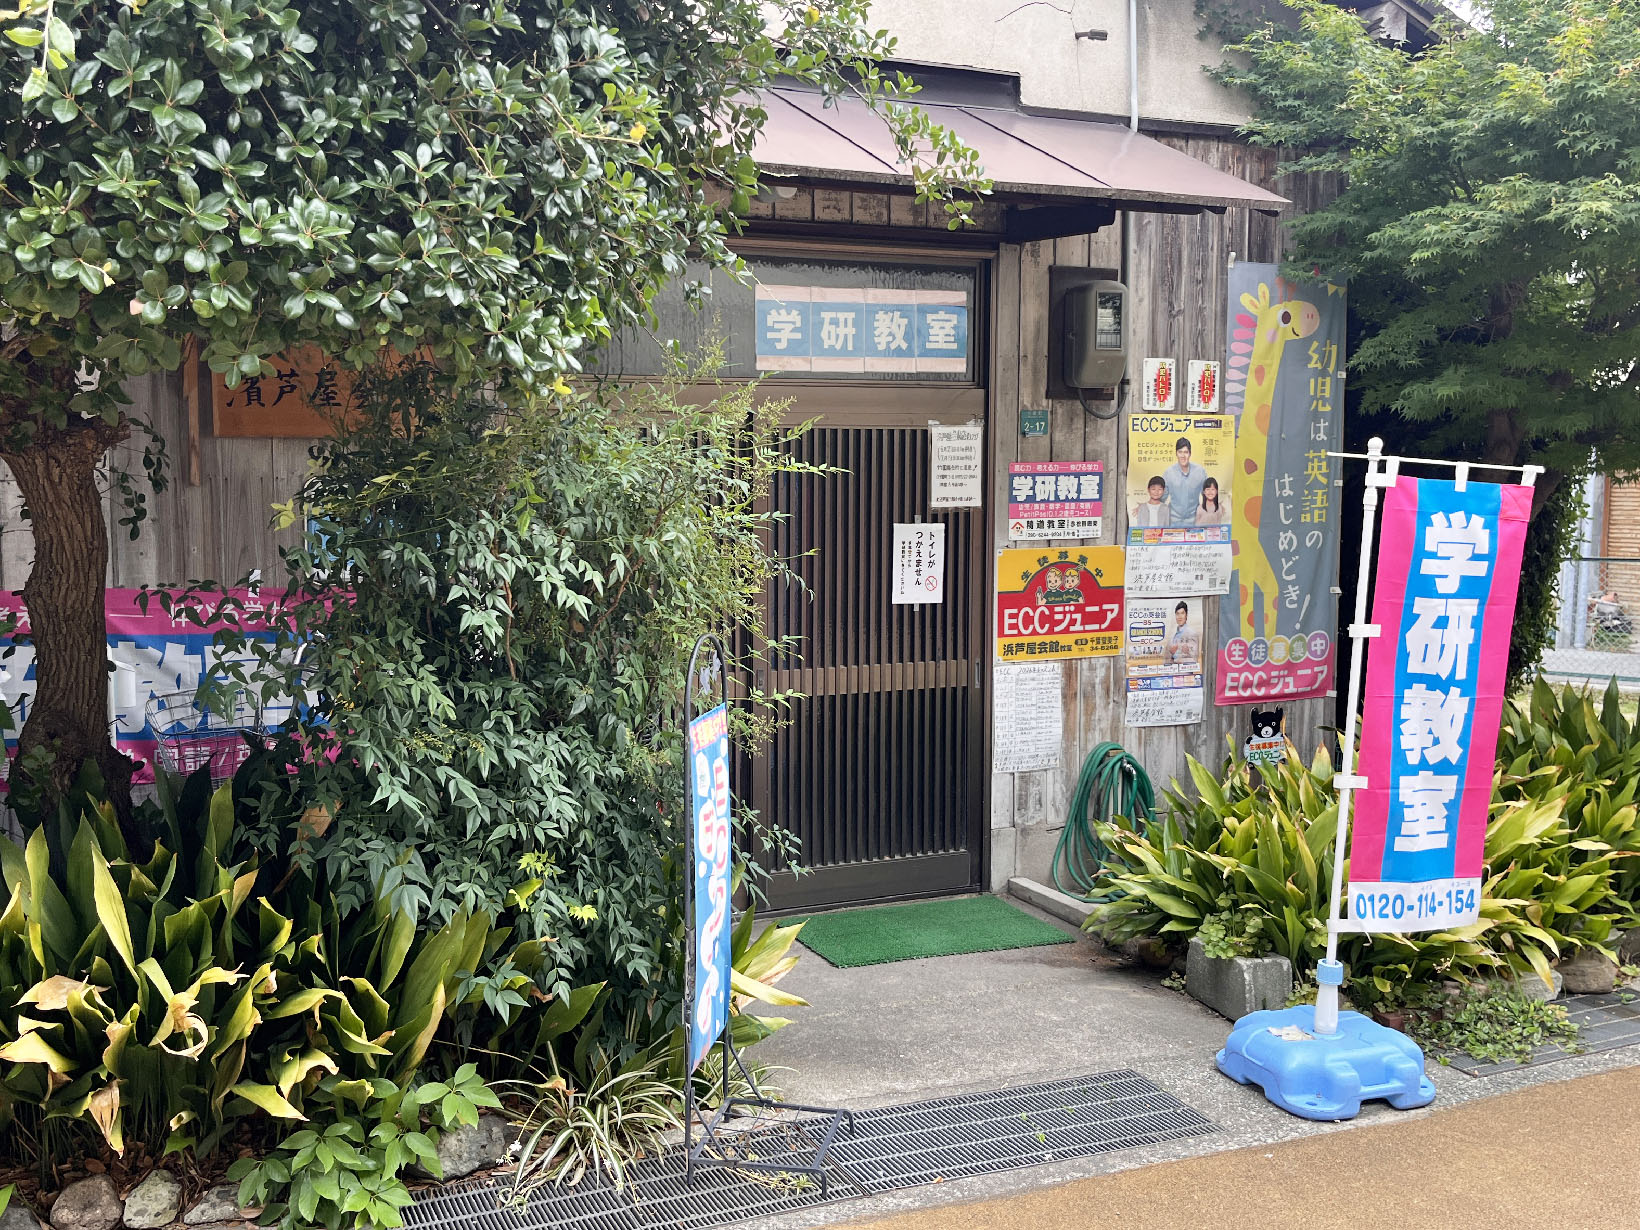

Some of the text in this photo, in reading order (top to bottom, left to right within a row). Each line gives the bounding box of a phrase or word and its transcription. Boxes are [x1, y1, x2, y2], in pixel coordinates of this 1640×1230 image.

[766, 308, 958, 351] 学研教室
[1024, 421, 1046, 432] 2-17
[1131, 416, 1192, 433] ECCジュニア
[1301, 340, 1337, 550] 幼児は英語の
[1012, 474, 1100, 502] 学研教室
[914, 531, 924, 586] つかえません
[927, 531, 936, 569] トイレが
[1021, 550, 1104, 583] 生徒募集中
[1003, 603, 1120, 635] ECCジュニア
[1229, 637, 1326, 661] 生徒募集中
[1225, 664, 1328, 697] ECCジュニア
[1393, 510, 1490, 853] 学研教室
[1355, 888, 1476, 920] 0120-114-154
